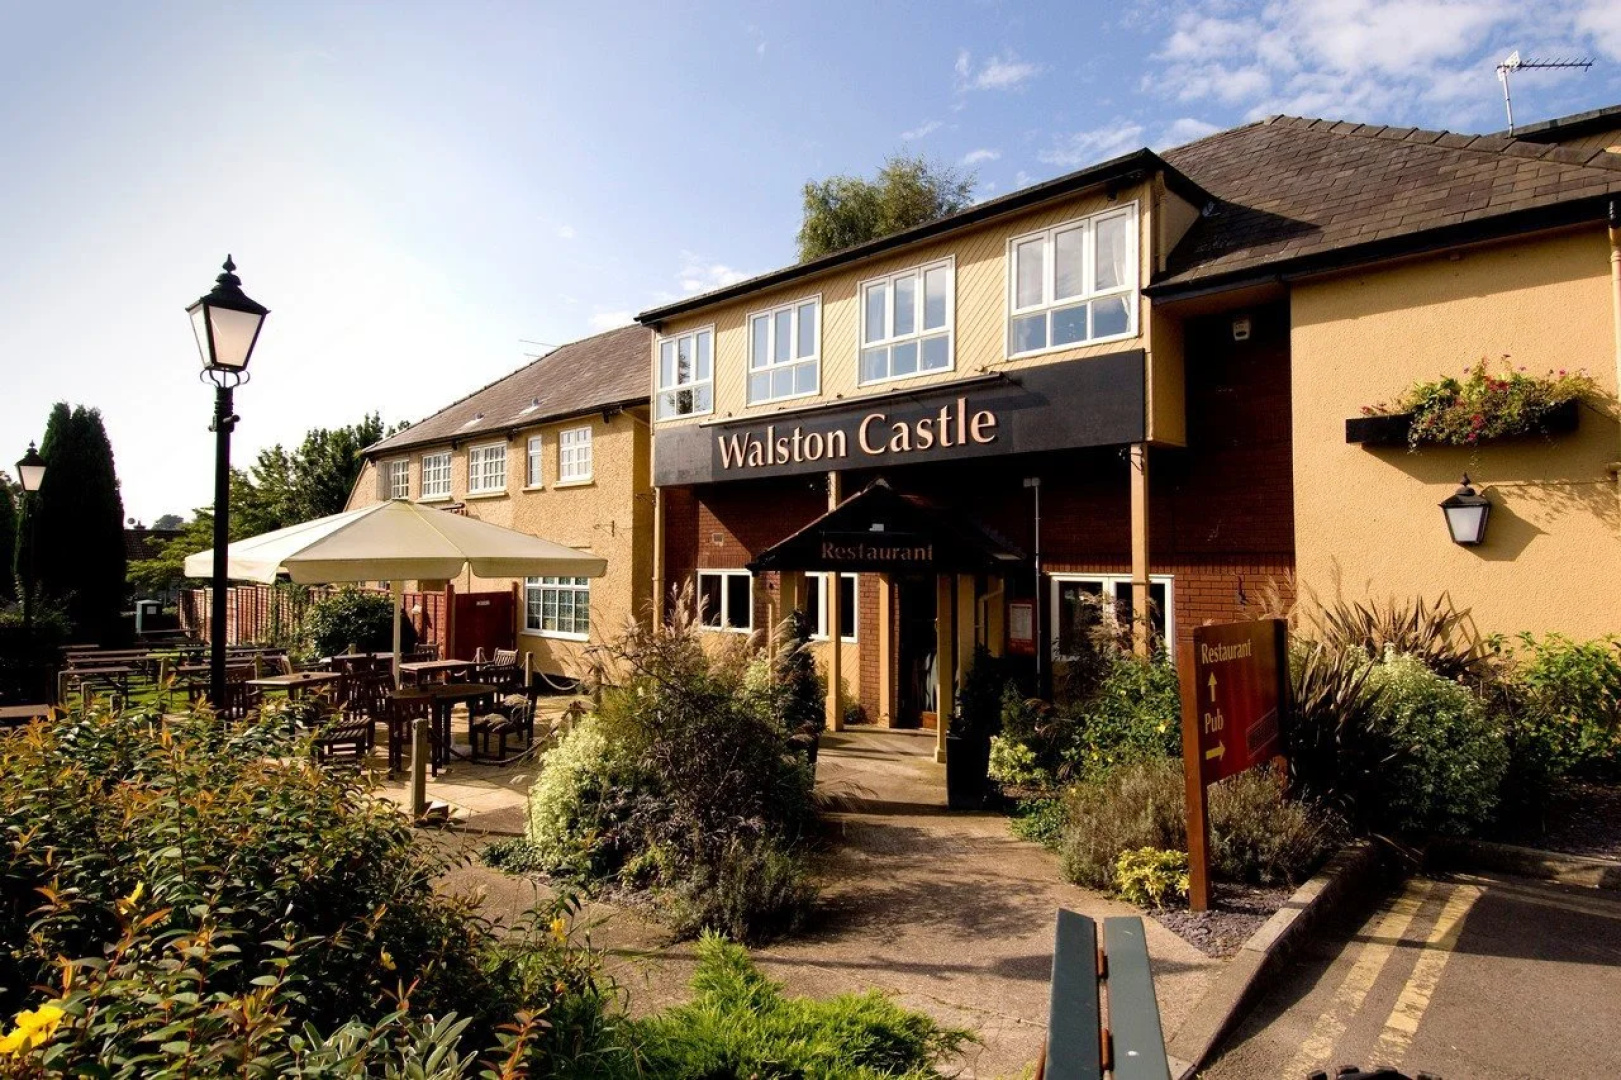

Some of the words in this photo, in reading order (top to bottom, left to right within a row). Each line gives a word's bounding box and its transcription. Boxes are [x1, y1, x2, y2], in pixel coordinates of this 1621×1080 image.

[717, 425, 847, 470] Walston
[858, 397, 998, 456] Castle
[820, 540, 934, 562] Restaurant
[1201, 639, 1252, 665] Restaurant
[1204, 708, 1224, 735] Pub
